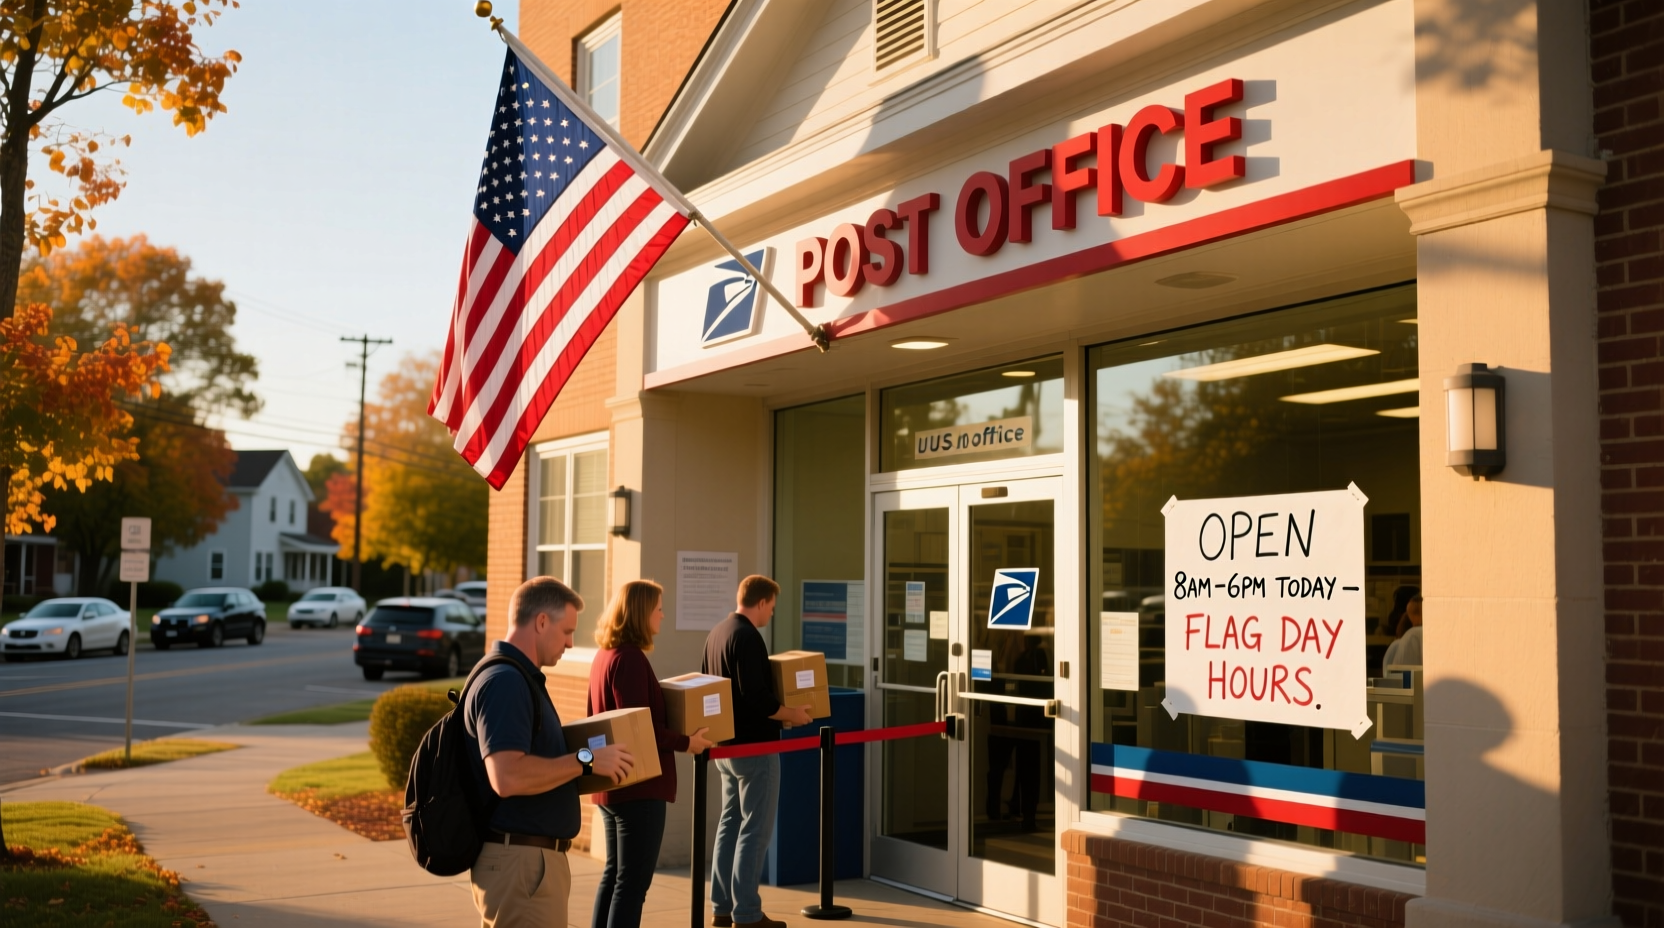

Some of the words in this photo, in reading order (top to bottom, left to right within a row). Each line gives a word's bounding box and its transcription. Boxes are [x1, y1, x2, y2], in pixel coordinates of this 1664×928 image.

[796, 193, 940, 307] POST
[956, 78, 1246, 256] OFFICE
[1199, 509, 1315, 561] OPEN
[1185, 613, 1262, 652] FLAG
[1281, 616, 1344, 660] DAY
[1208, 661, 1322, 710] HOURS.
